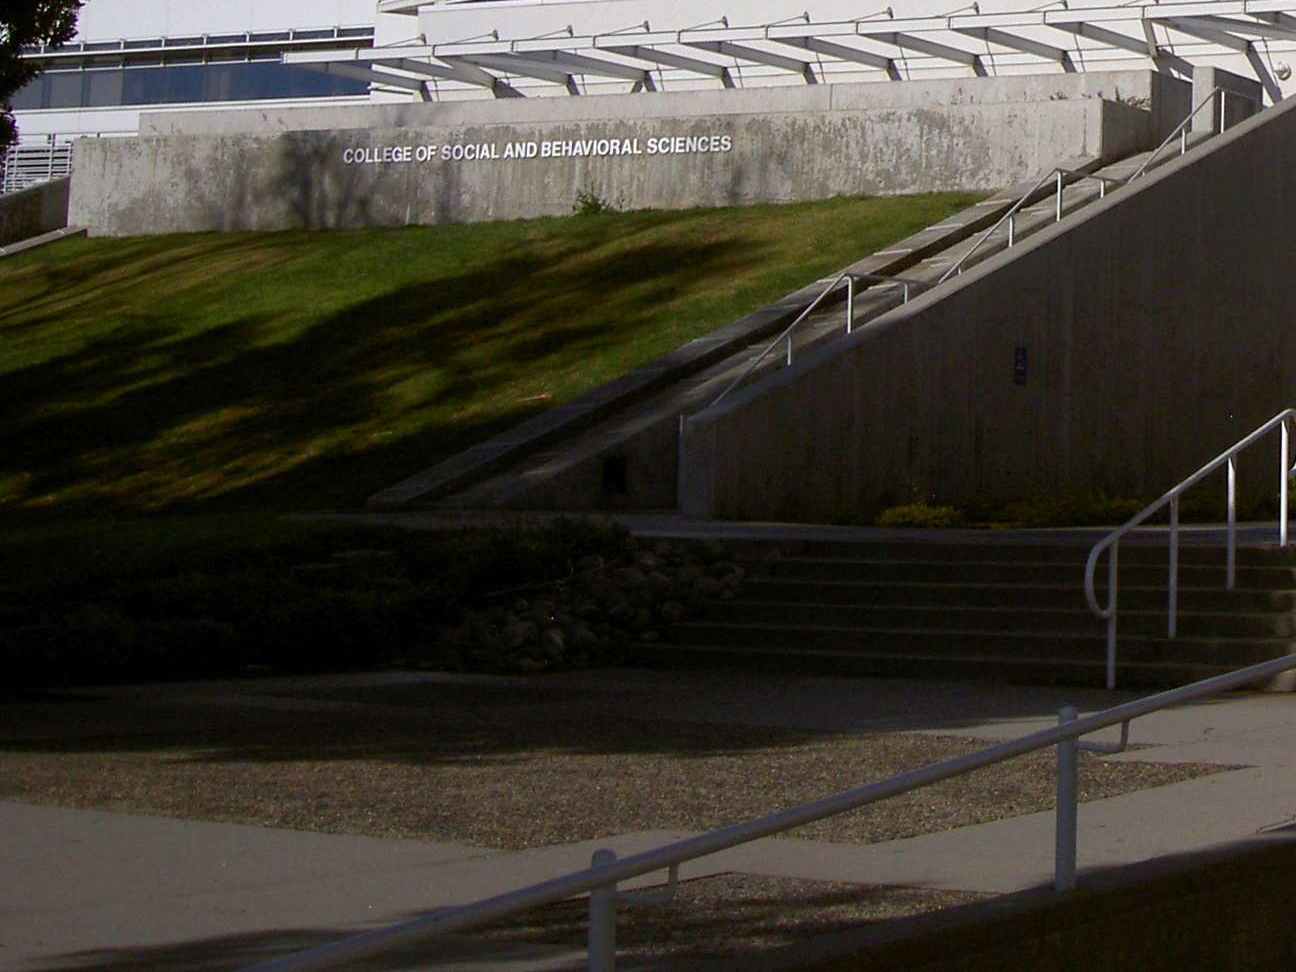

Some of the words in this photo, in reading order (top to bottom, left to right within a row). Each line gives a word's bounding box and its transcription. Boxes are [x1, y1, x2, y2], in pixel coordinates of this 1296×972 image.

[343, 147, 412, 164] COLLEGE
[415, 145, 437, 161] OF
[441, 143, 499, 161] SOCIAL
[503, 142, 537, 159] AND
[541, 139, 641, 158] BEHAVIORAL
[646, 135, 731, 155] SCIENCES
